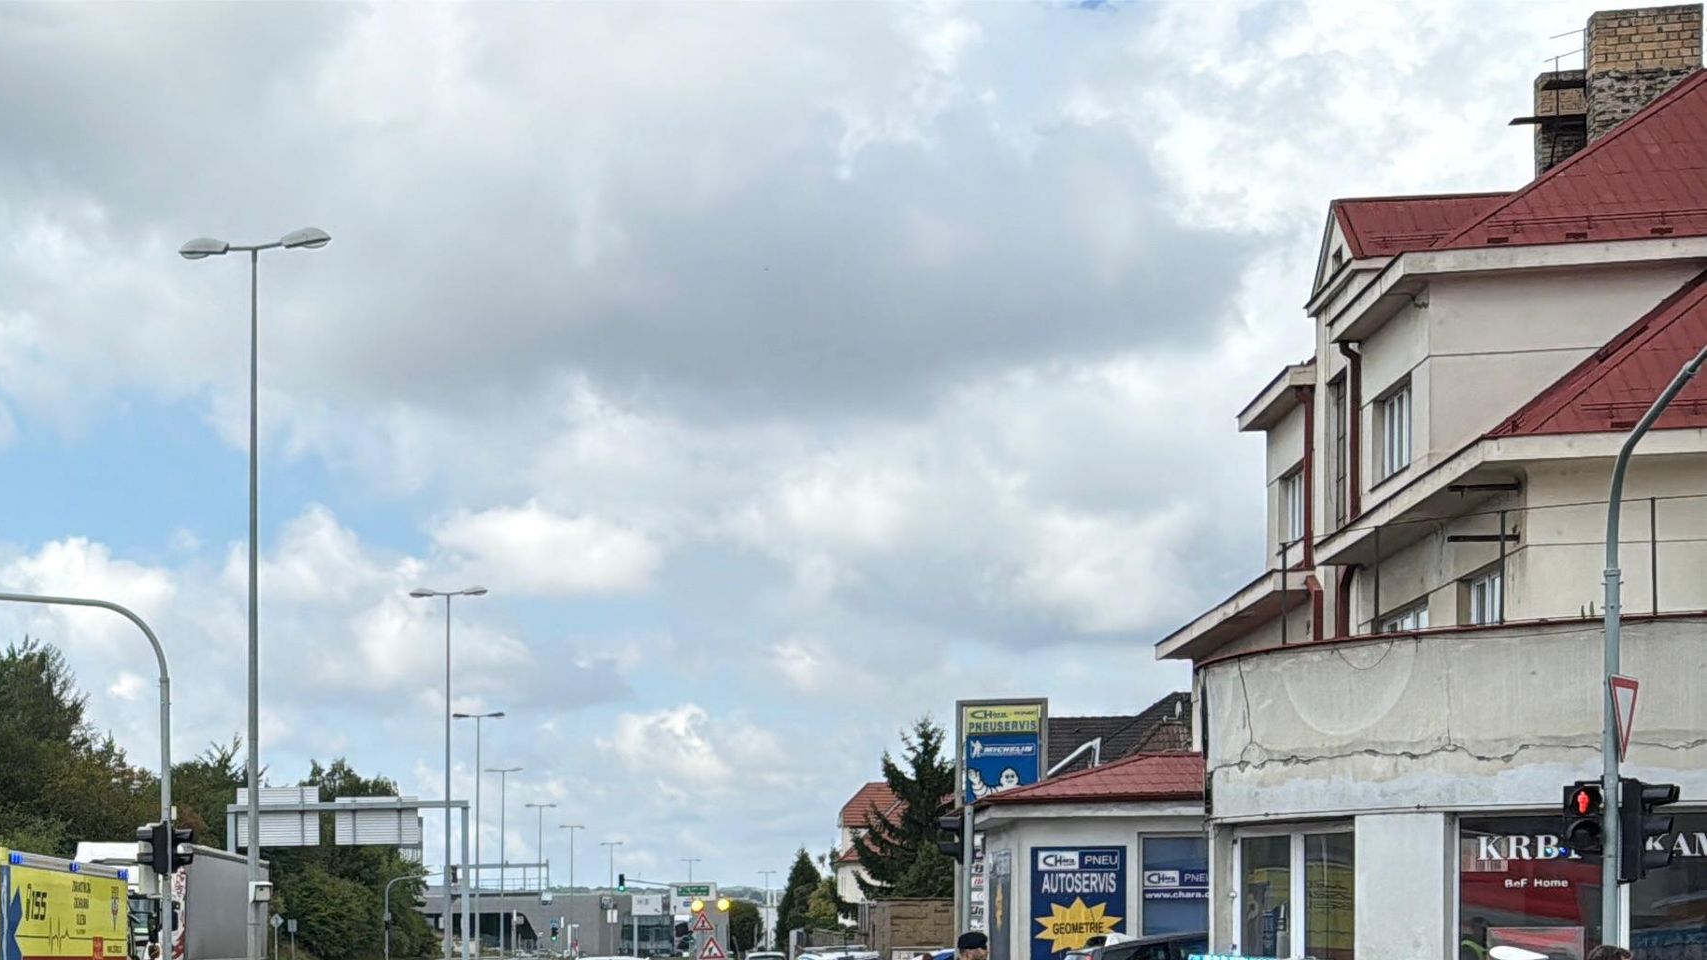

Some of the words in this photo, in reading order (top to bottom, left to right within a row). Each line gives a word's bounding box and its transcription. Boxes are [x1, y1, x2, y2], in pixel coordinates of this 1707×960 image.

[968, 720, 1037, 732] PNEUSERVIS
[983, 745, 1033, 753] MICHELIN
[1477, 834, 1583, 861] KRB
[1084, 855, 1118, 865] PNEU
[1041, 873, 1117, 894] AUTOSERVIS
[1184, 872, 1209, 883] PNE
[1533, 878, 1569, 888] Home
[31, 890, 48, 921] 155
[1052, 921, 1104, 935] GEOMETRIE
